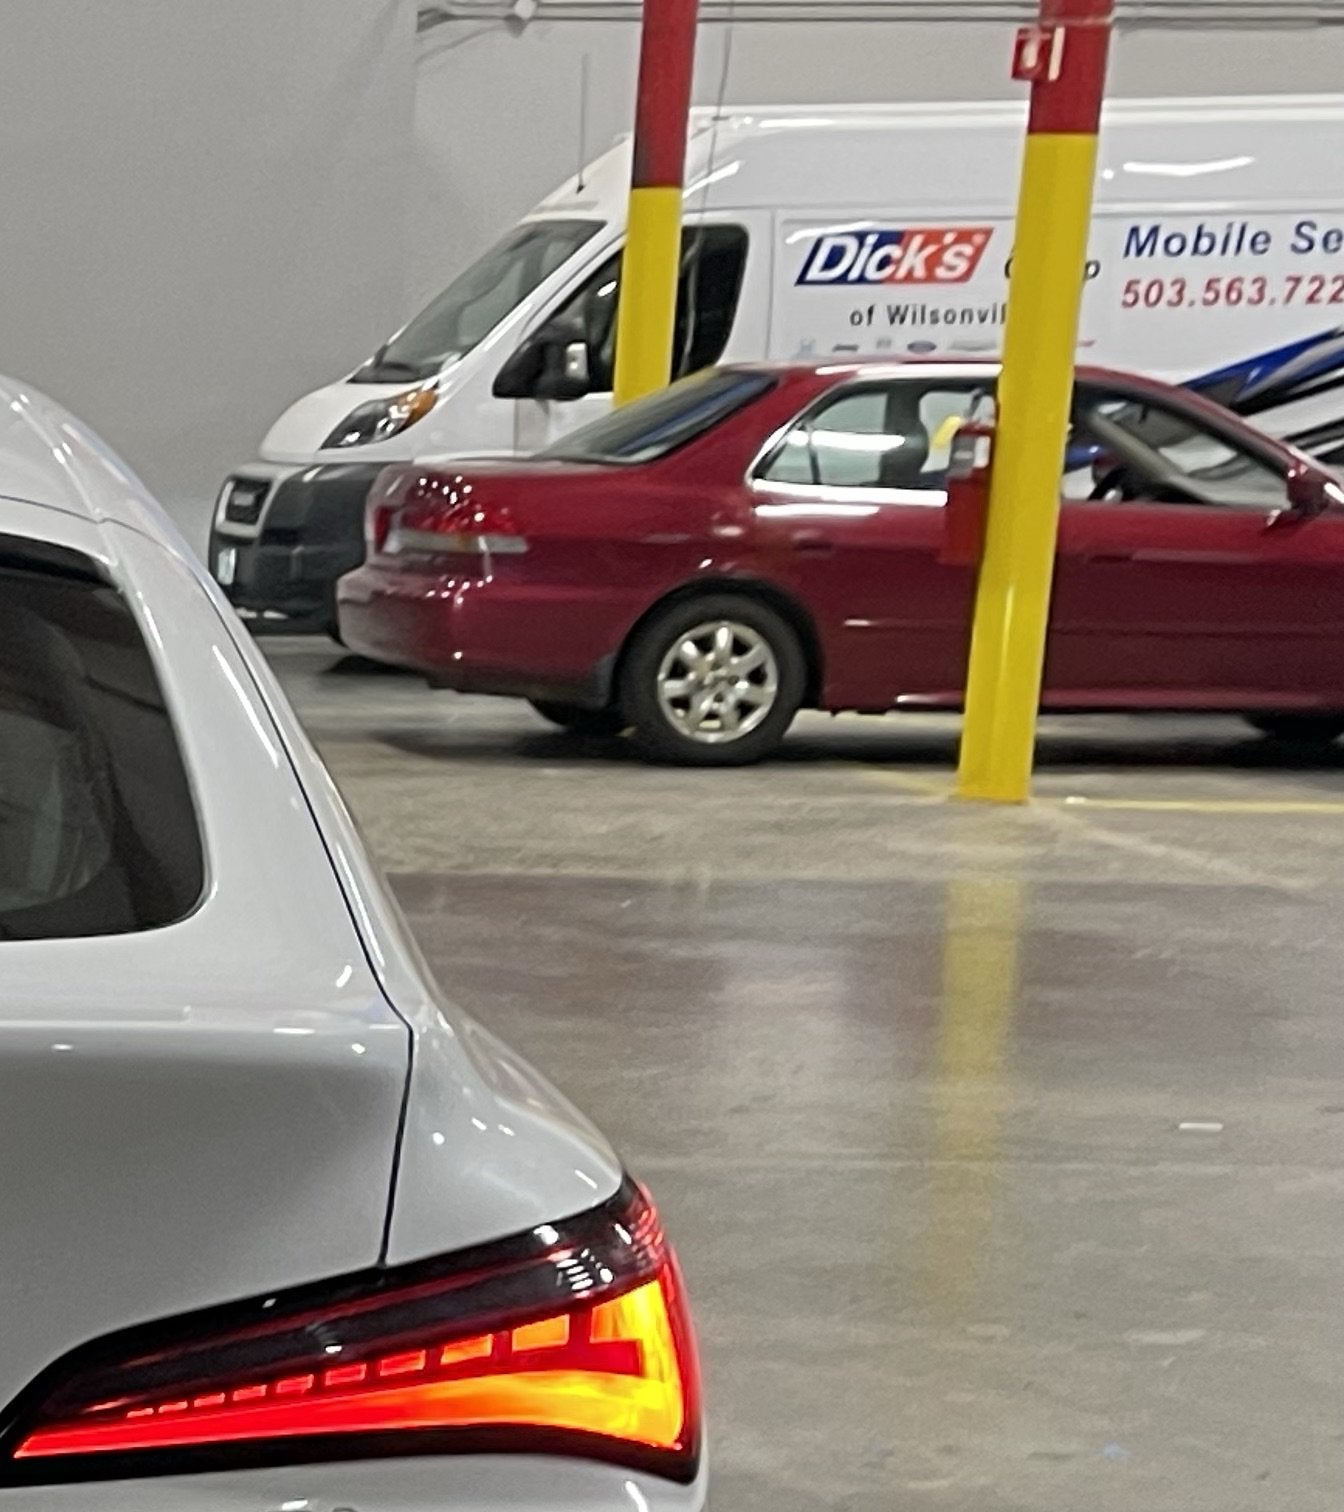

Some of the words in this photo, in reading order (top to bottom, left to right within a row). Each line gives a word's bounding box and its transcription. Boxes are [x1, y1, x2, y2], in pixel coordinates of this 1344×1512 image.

[804, 232, 972, 282] Dick's
[1123, 222, 1272, 258] Mobile
[849, 304, 875, 327] of
[886, 302, 1007, 327] Wilsonvil
